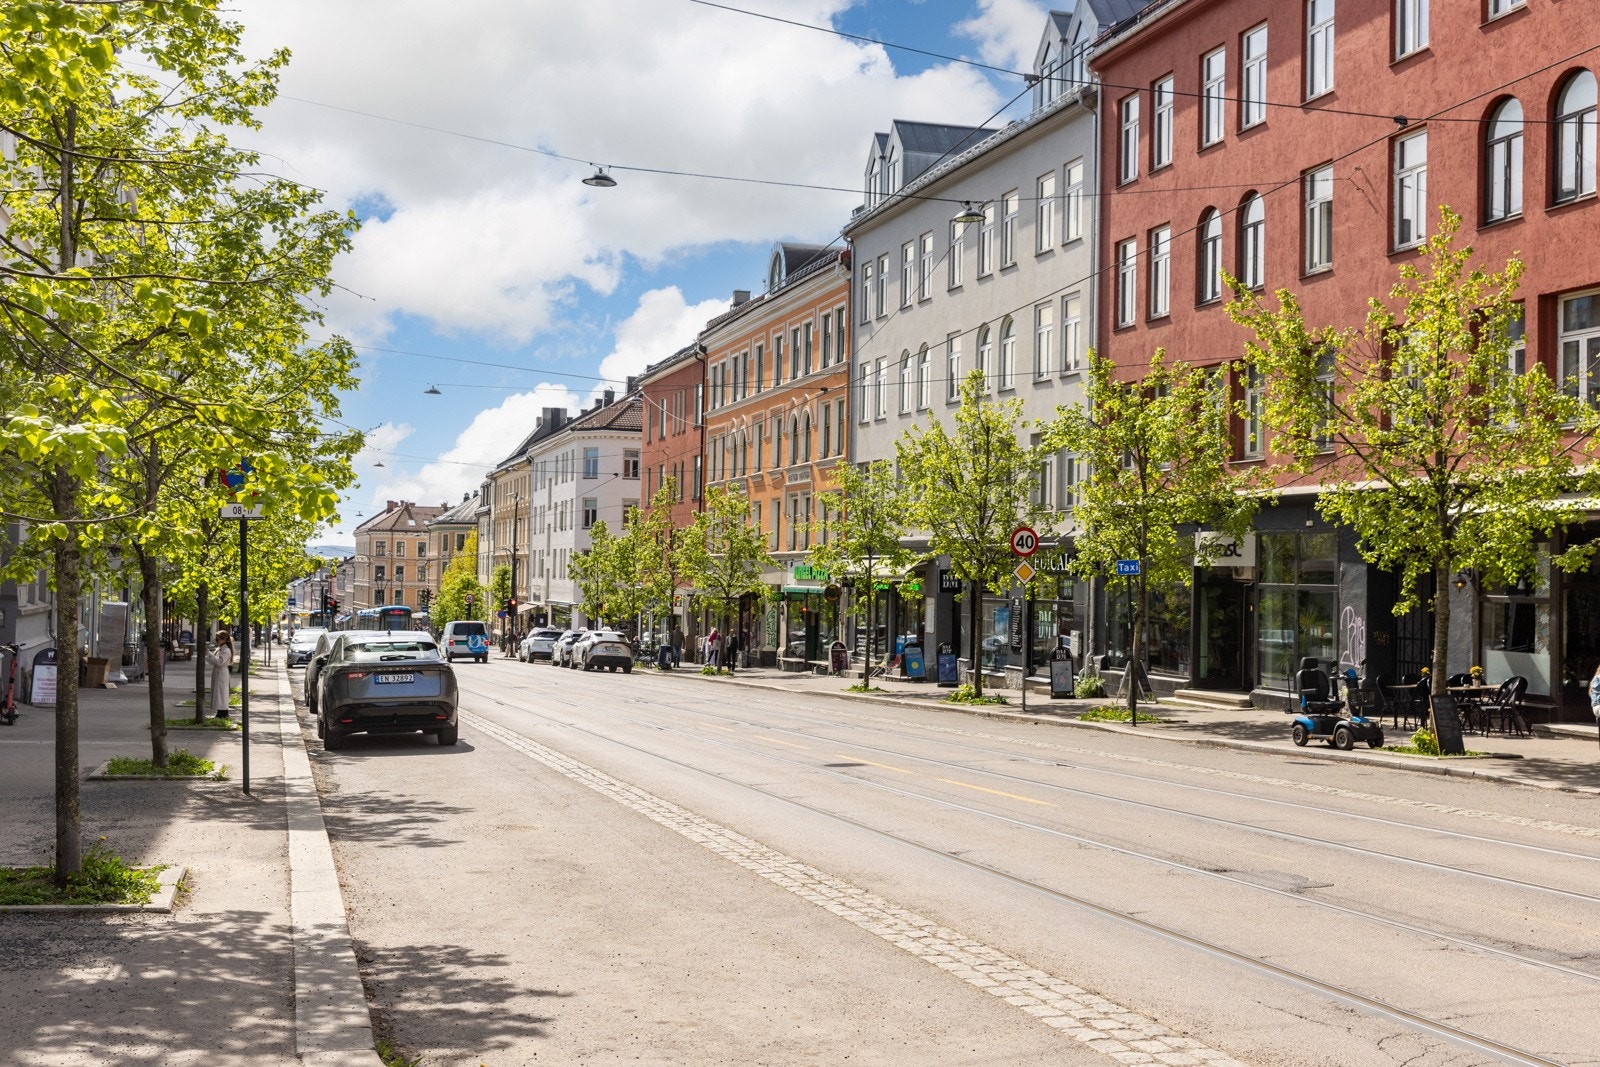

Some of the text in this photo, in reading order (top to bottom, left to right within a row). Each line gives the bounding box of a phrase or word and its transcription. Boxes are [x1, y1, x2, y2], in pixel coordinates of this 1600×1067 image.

[1016, 534, 1034, 549] 40
[1118, 562, 1139, 572] Taxi
[380, 674, 413, 682] EN 32892
